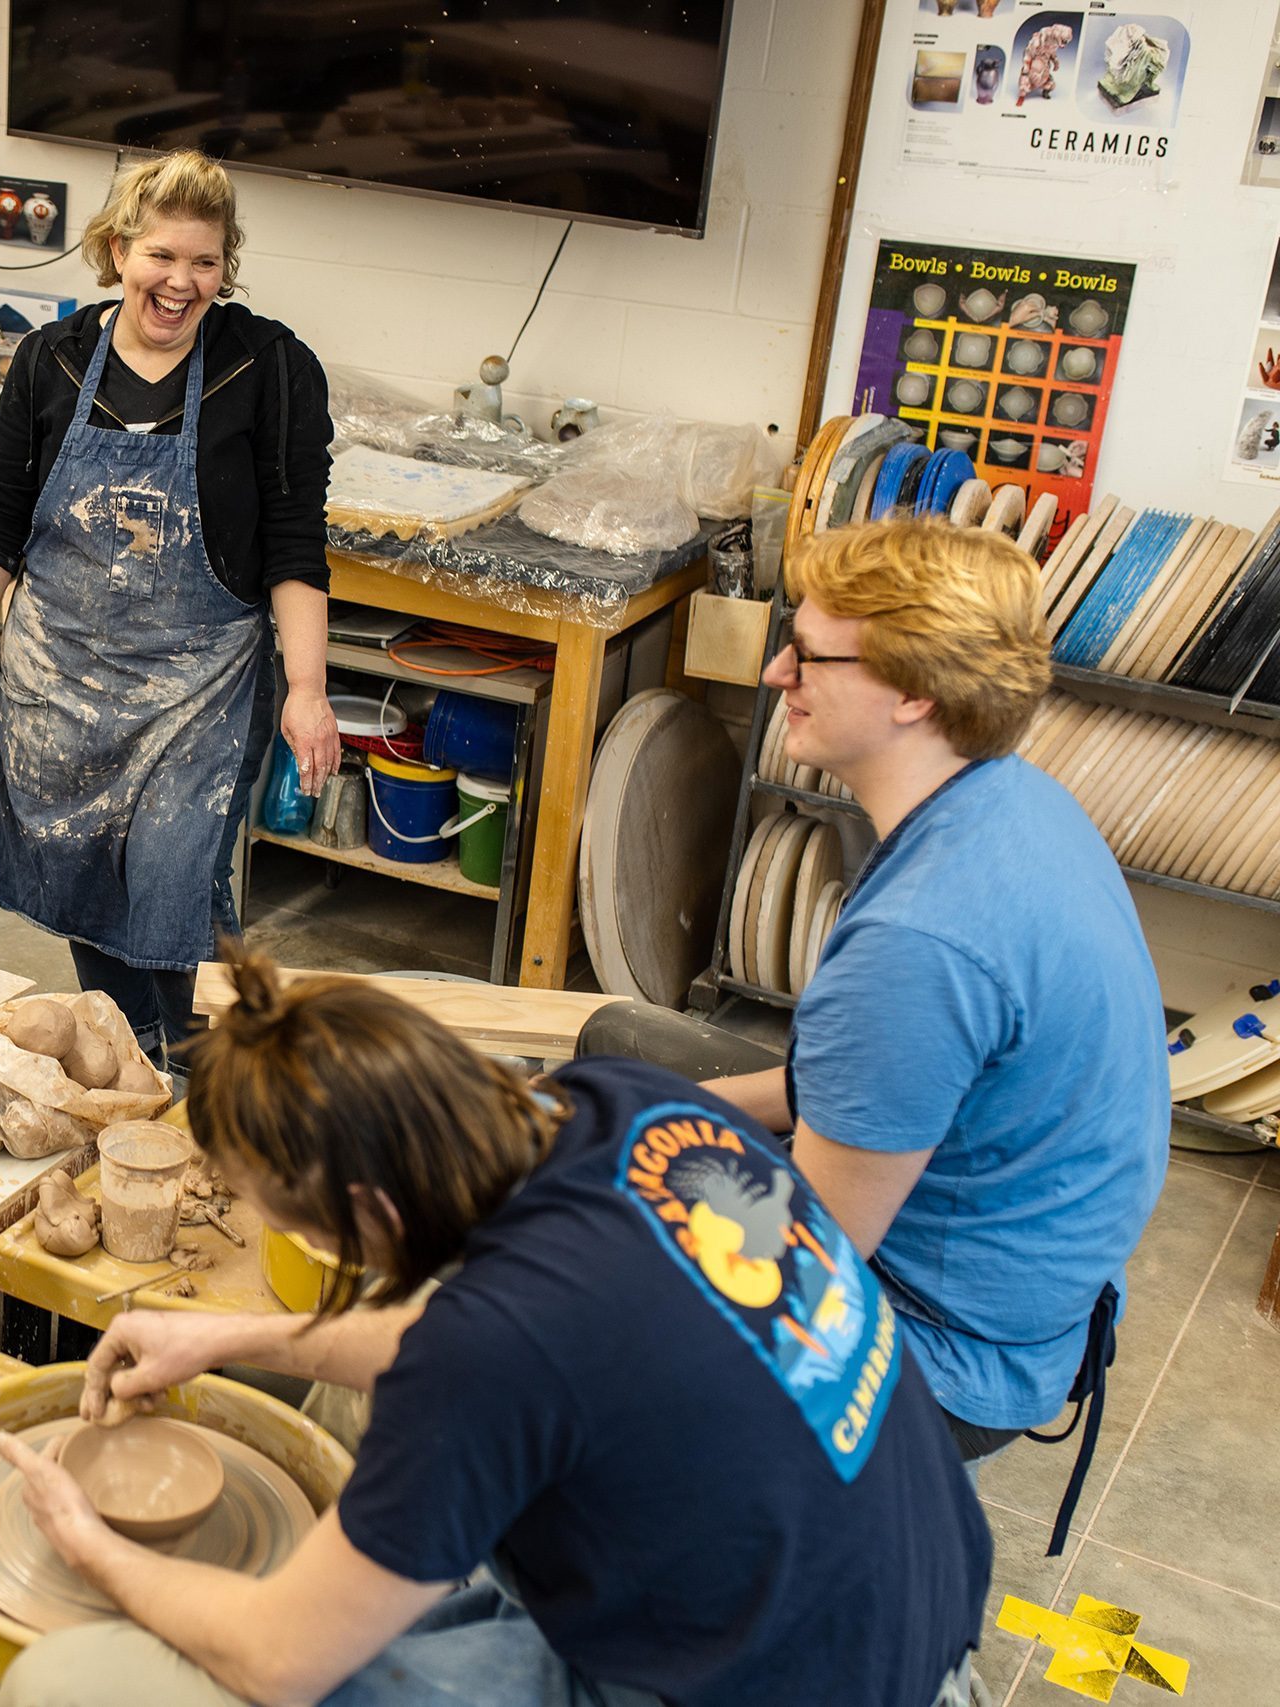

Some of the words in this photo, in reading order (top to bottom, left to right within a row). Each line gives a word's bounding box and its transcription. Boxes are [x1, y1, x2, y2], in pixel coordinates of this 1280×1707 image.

[1030, 128, 1169, 158] CERAMICS
[1040, 151, 1090, 164] EDINBORO
[1094, 154, 1154, 168] UNIVERSITY
[889, 253, 948, 276] Bowls
[970, 261, 1031, 284] Bowls
[1054, 270, 1118, 293] Bowls
